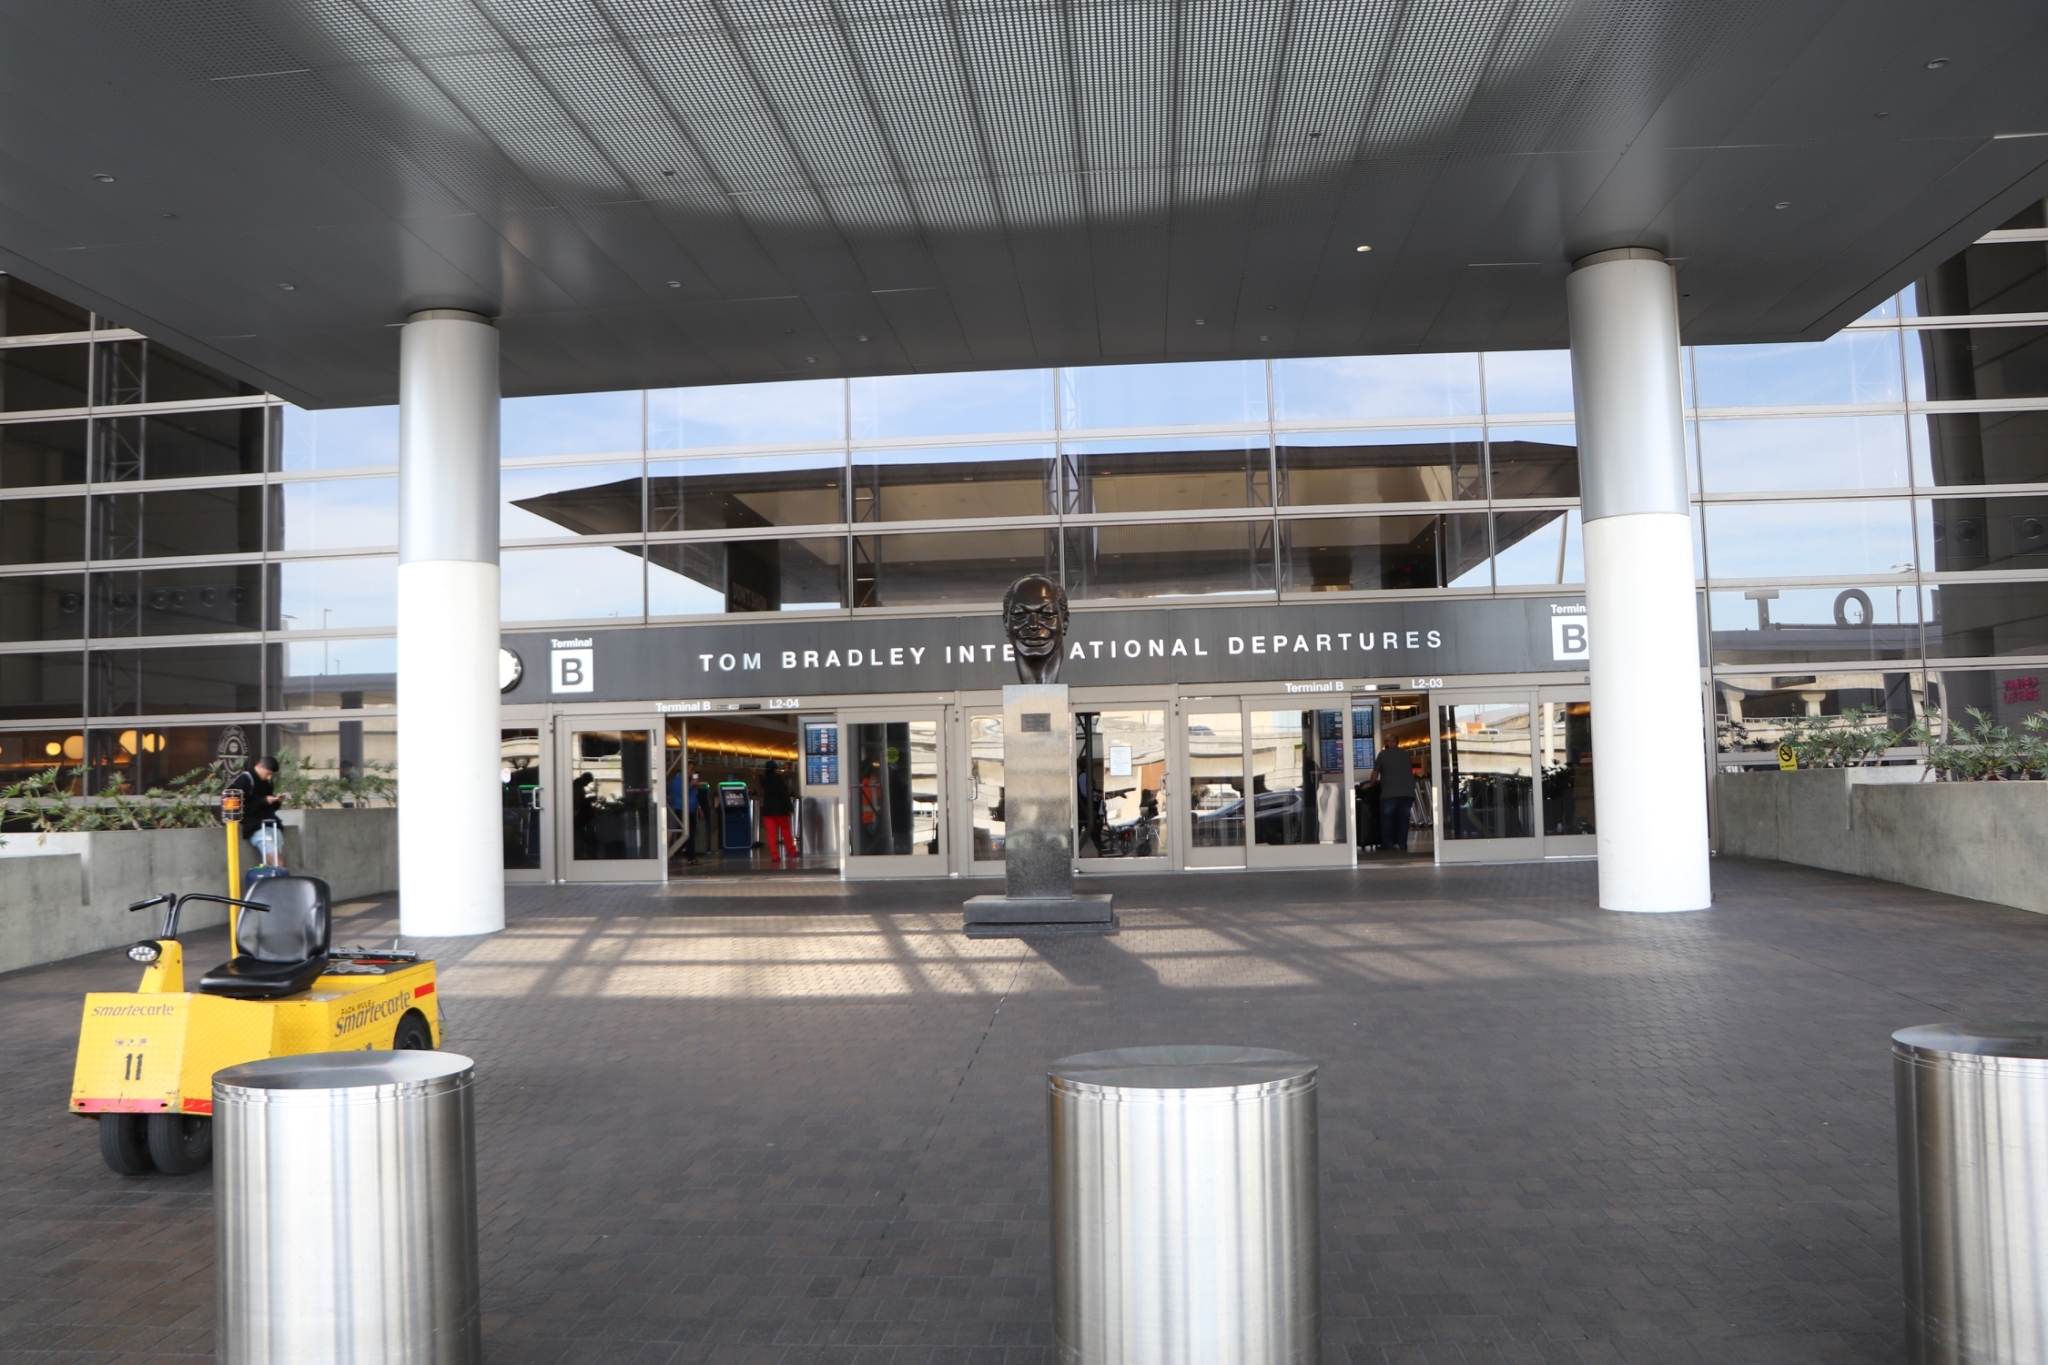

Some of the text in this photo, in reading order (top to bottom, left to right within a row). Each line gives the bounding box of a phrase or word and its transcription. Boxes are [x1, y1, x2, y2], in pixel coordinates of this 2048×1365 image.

[1550, 603, 1587, 614] Termin
[551, 638, 593, 649] Terminal
[1562, 623, 1587, 653] B
[699, 630, 1442, 671] TOM BRADLEY INTEATIONAL DEPARTURES
[561, 657, 584, 686] B
[1285, 681, 1332, 693] Terminal
[1335, 681, 1344, 691] B
[1411, 678, 1443, 689] L2-03
[655, 701, 700, 713] Terminal
[703, 701, 711, 711] B
[769, 698, 800, 709] L2-04
[91, 1003, 174, 1017] smartecarte
[334, 990, 411, 1038] smartecarte
[125, 1053, 143, 1081] 11
